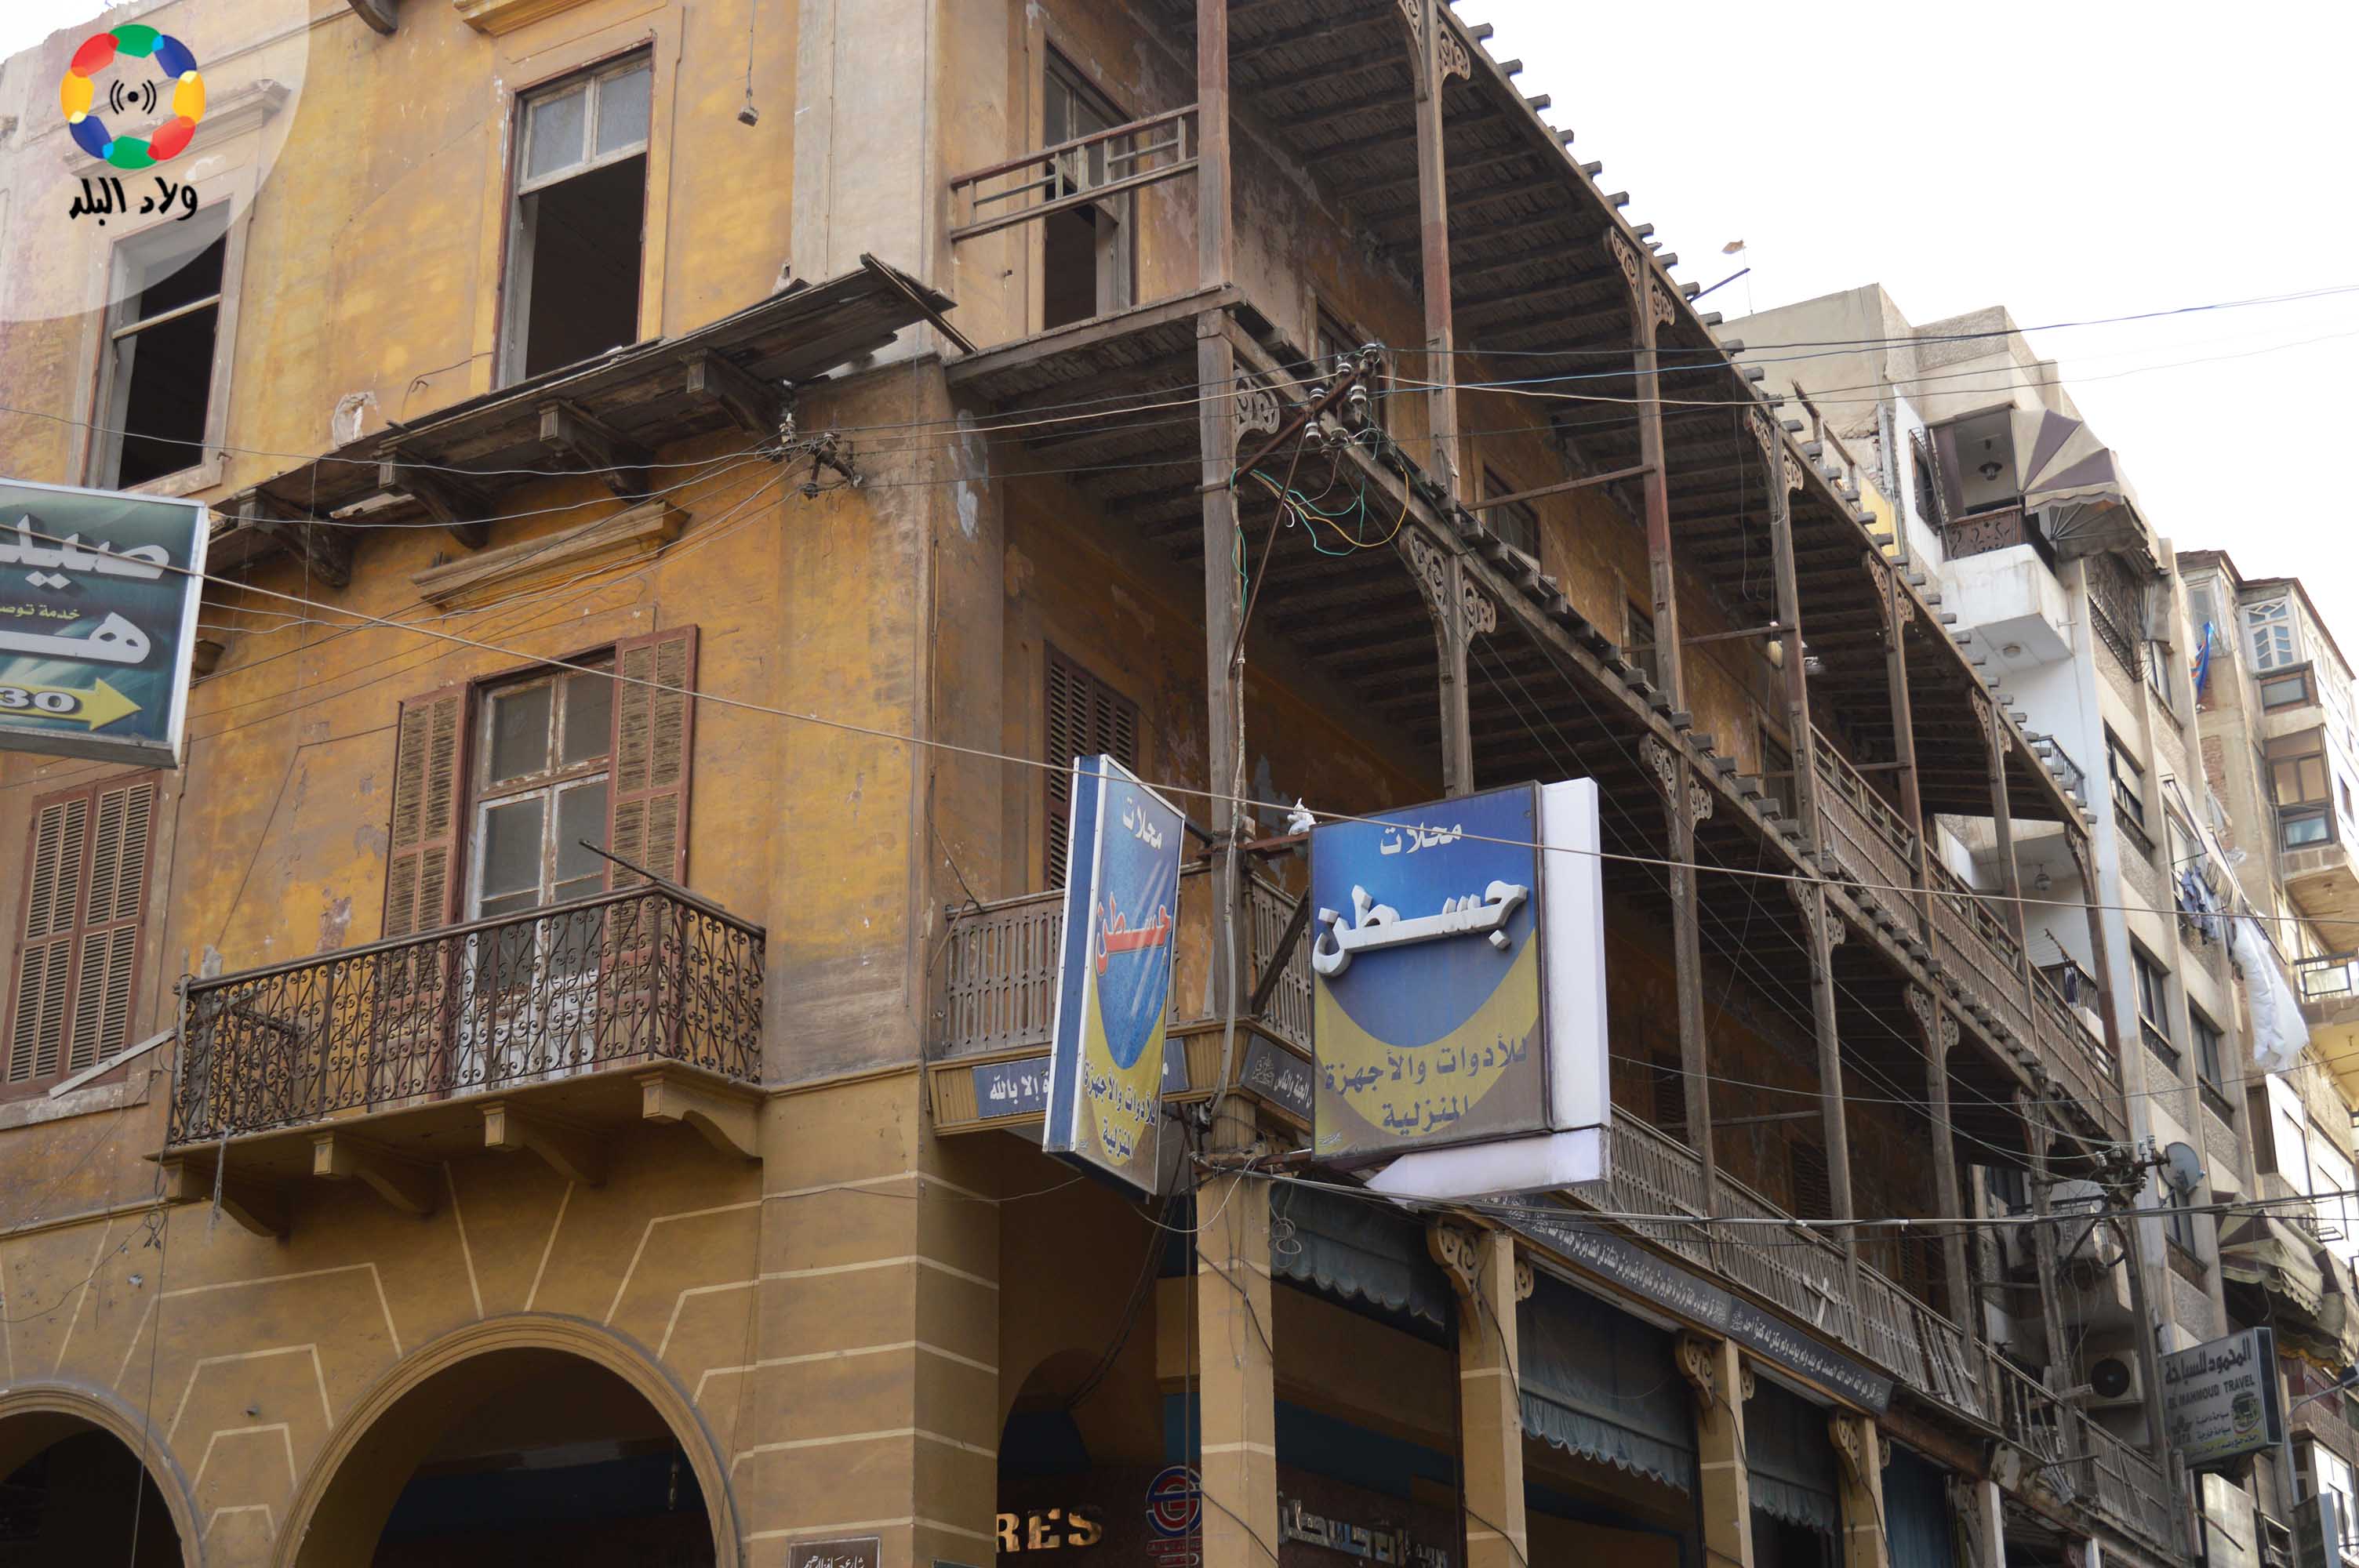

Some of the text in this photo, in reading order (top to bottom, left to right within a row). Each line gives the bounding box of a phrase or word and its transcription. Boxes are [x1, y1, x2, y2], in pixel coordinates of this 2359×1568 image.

[38, 604, 81, 620] خدمة
[1122, 797, 1162, 850] محلات
[1379, 821, 1463, 855] محلات
[1323, 1047, 1427, 1095] والأجهزة
[1436, 1032, 1528, 1076] للأدوات
[990, 1073, 1018, 1105] بالله
[1021, 1074, 1040, 1102] إلا
[1380, 1094, 1470, 1137] المنزلية
[2165, 1335, 2252, 1385] المحمود للسياحة
[2179, 1384, 2219, 1406] MAHMOUD
[2223, 1374, 2255, 1393] TRAVEL
